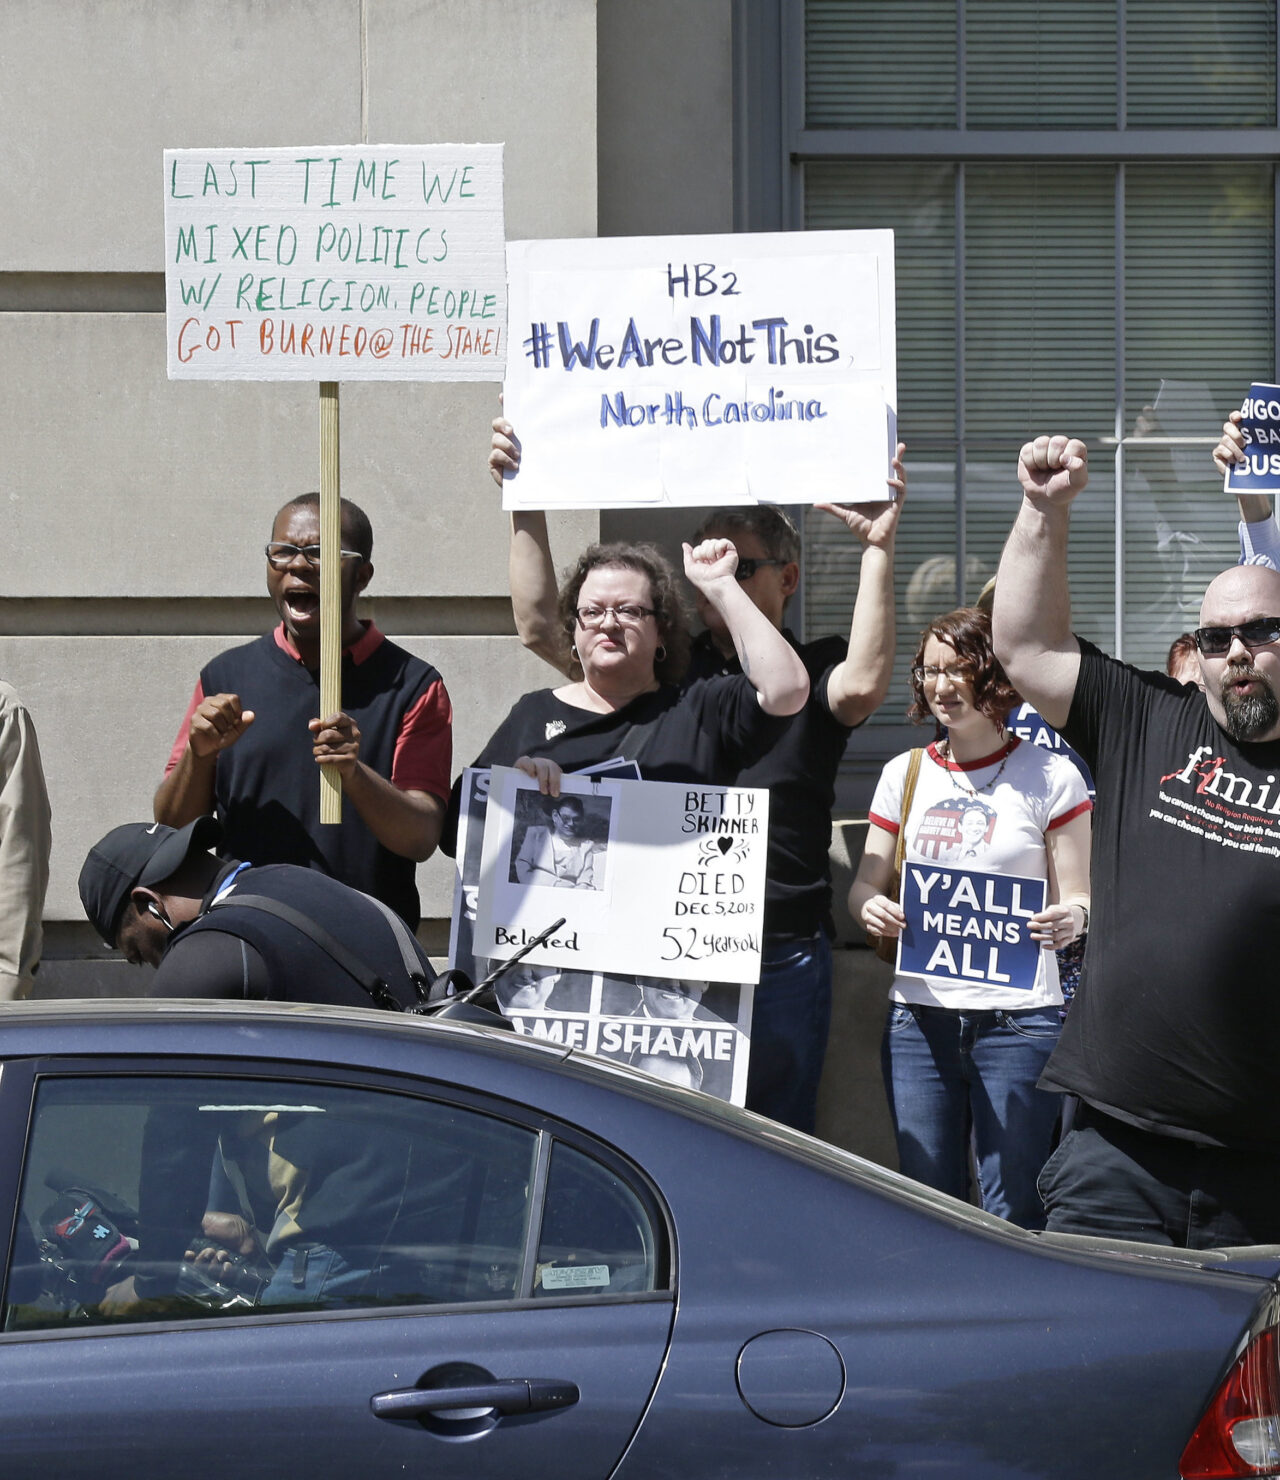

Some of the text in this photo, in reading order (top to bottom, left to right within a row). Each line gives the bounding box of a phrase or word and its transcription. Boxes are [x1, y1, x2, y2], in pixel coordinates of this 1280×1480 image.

[171, 157, 476, 208] LAST TIME WE
[175, 222, 449, 268] MIXED POLITICS
[179, 272, 223, 312] W/
[409, 281, 497, 319] PEOPLE
[666, 262, 742, 298] HB2
[177, 316, 243, 363] GOT
[599, 385, 828, 431] North Carolina
[1239, 427, 1253, 445] S
[684, 791, 755, 816] BETTY
[1170, 797, 1198, 814] cannot
[1196, 807, 1225, 825] choose
[1222, 819, 1244, 832] your
[1243, 823, 1264, 836] birth
[1204, 799, 1275, 826] No Religion Required
[681, 812, 760, 835] SKINNER
[1149, 808, 1164, 820] you
[1163, 814, 1178, 826] can
[1176, 819, 1205, 836] choose
[1204, 831, 1223, 843] who
[1221, 837, 1240, 849] you
[1239, 842, 1256, 852] call
[677, 871, 746, 896] DIED
[660, 926, 703, 961] 52
[922, 910, 1021, 944] MEANS
[925, 939, 1011, 983] ALL
[600, 1021, 733, 1061] SHAME
